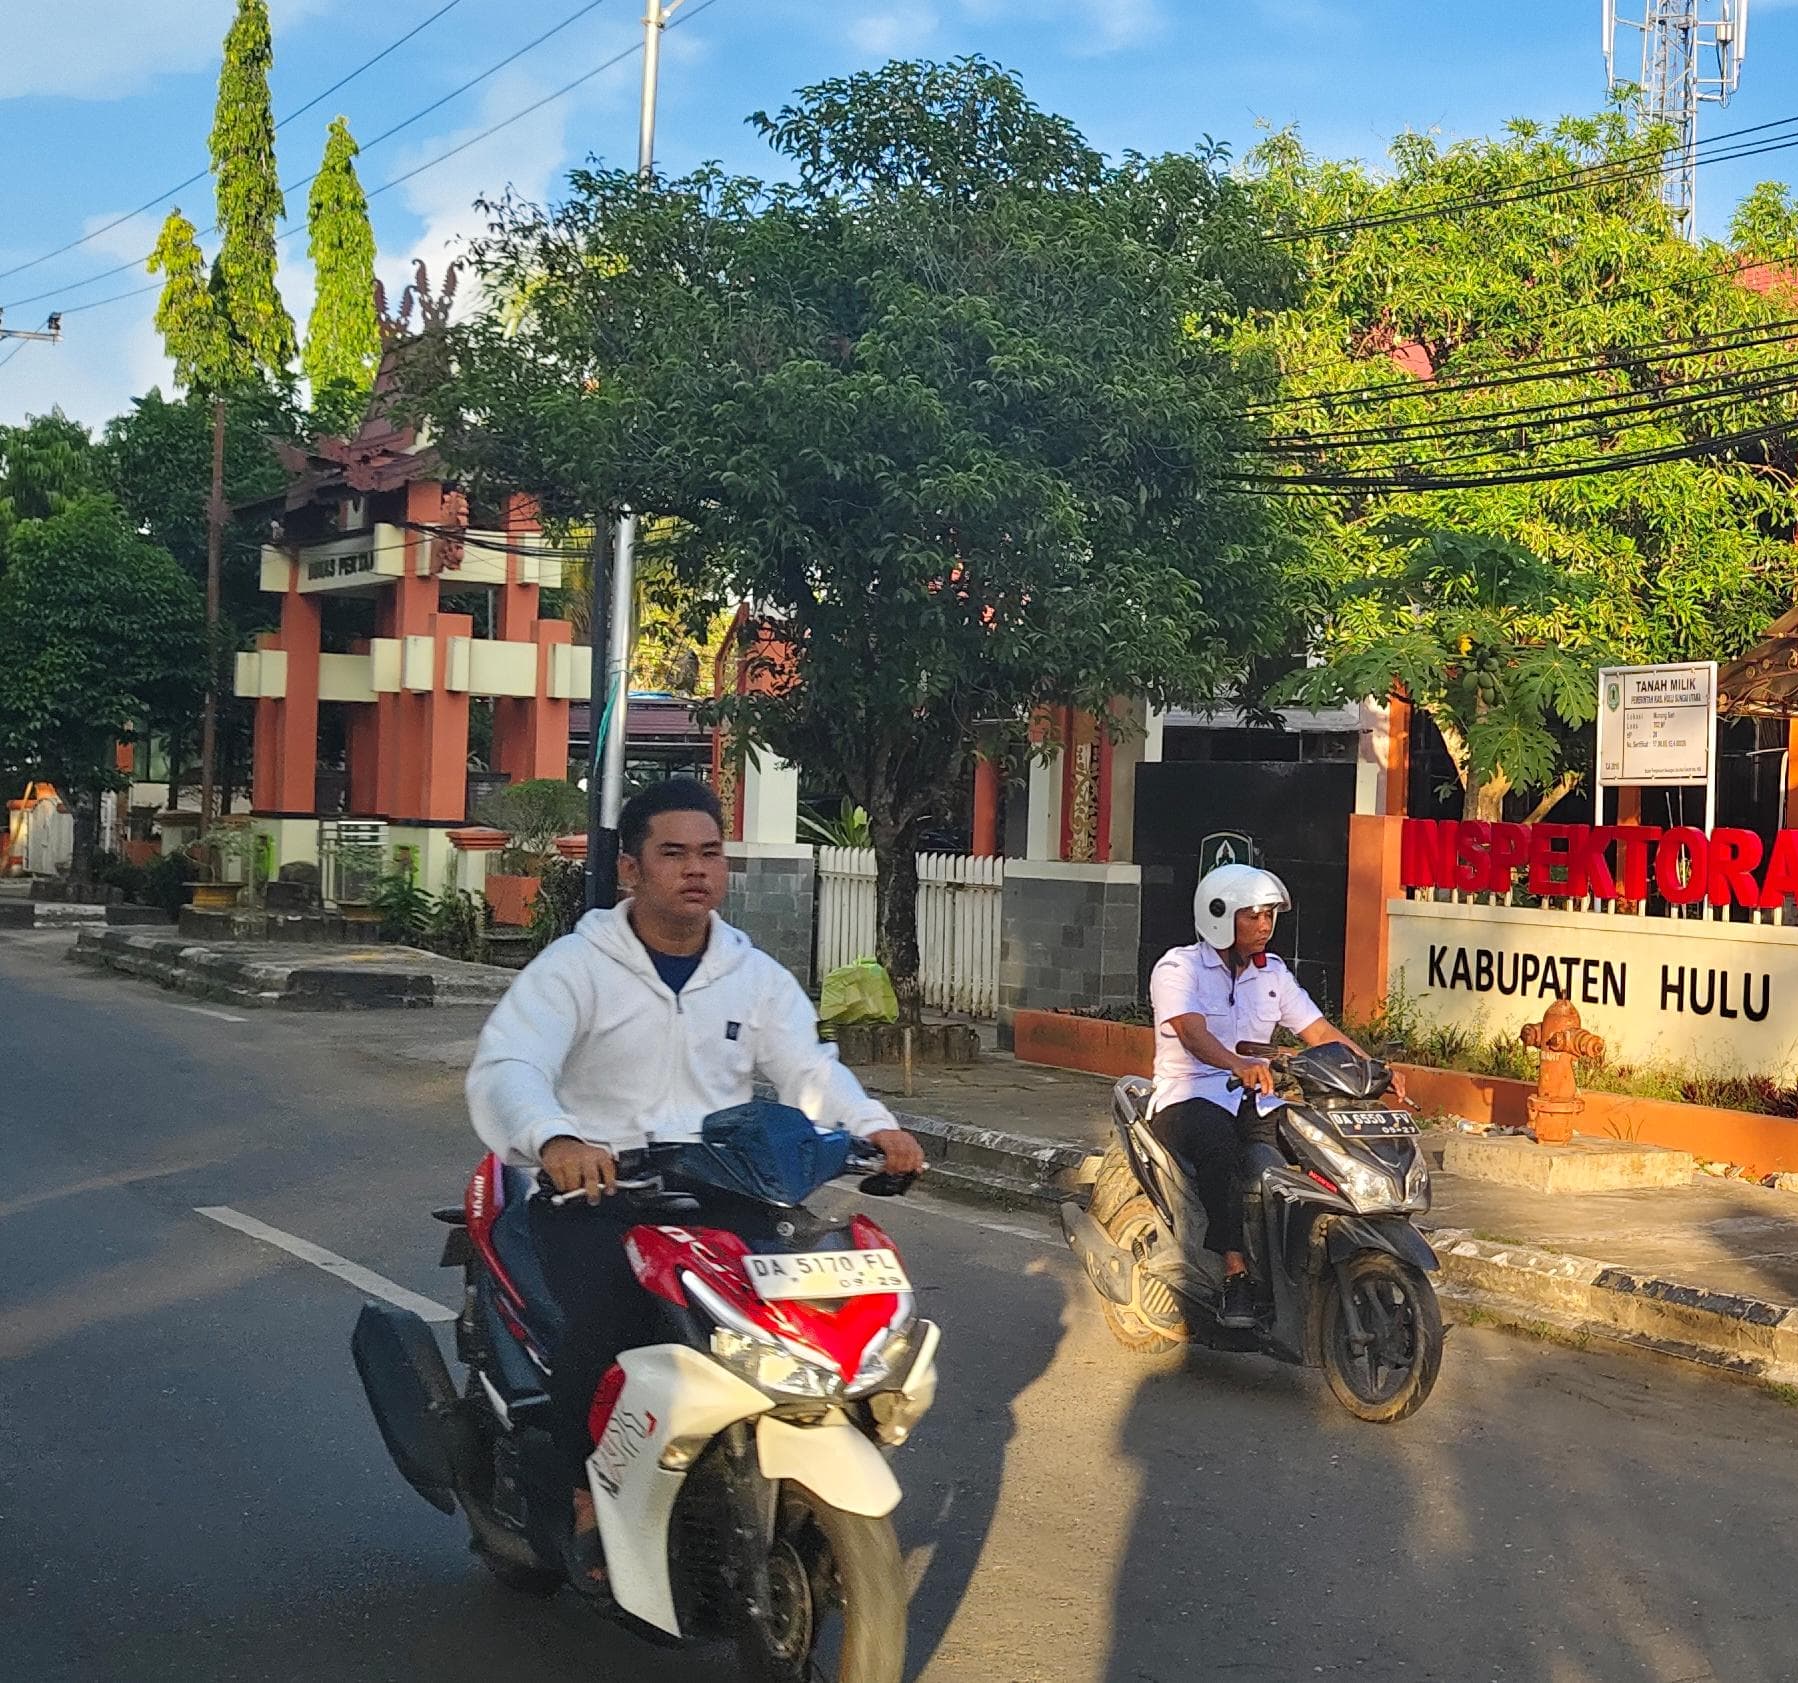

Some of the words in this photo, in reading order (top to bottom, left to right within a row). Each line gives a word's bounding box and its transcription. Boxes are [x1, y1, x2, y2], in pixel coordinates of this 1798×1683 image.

[1636, 680, 1667, 692] TANAH
[1671, 678, 1696, 690] MILIK
[1428, 945, 1627, 1006] KABUPATEN
[1660, 965, 1770, 1019] HULU
[1331, 1113, 1353, 1124] DA
[1352, 1113, 1386, 1124] 6550
[1391, 1113, 1410, 1124] FV
[753, 1259, 786, 1277] DA
[796, 1256, 855, 1274] 5170
[862, 1253, 896, 1269] FL
